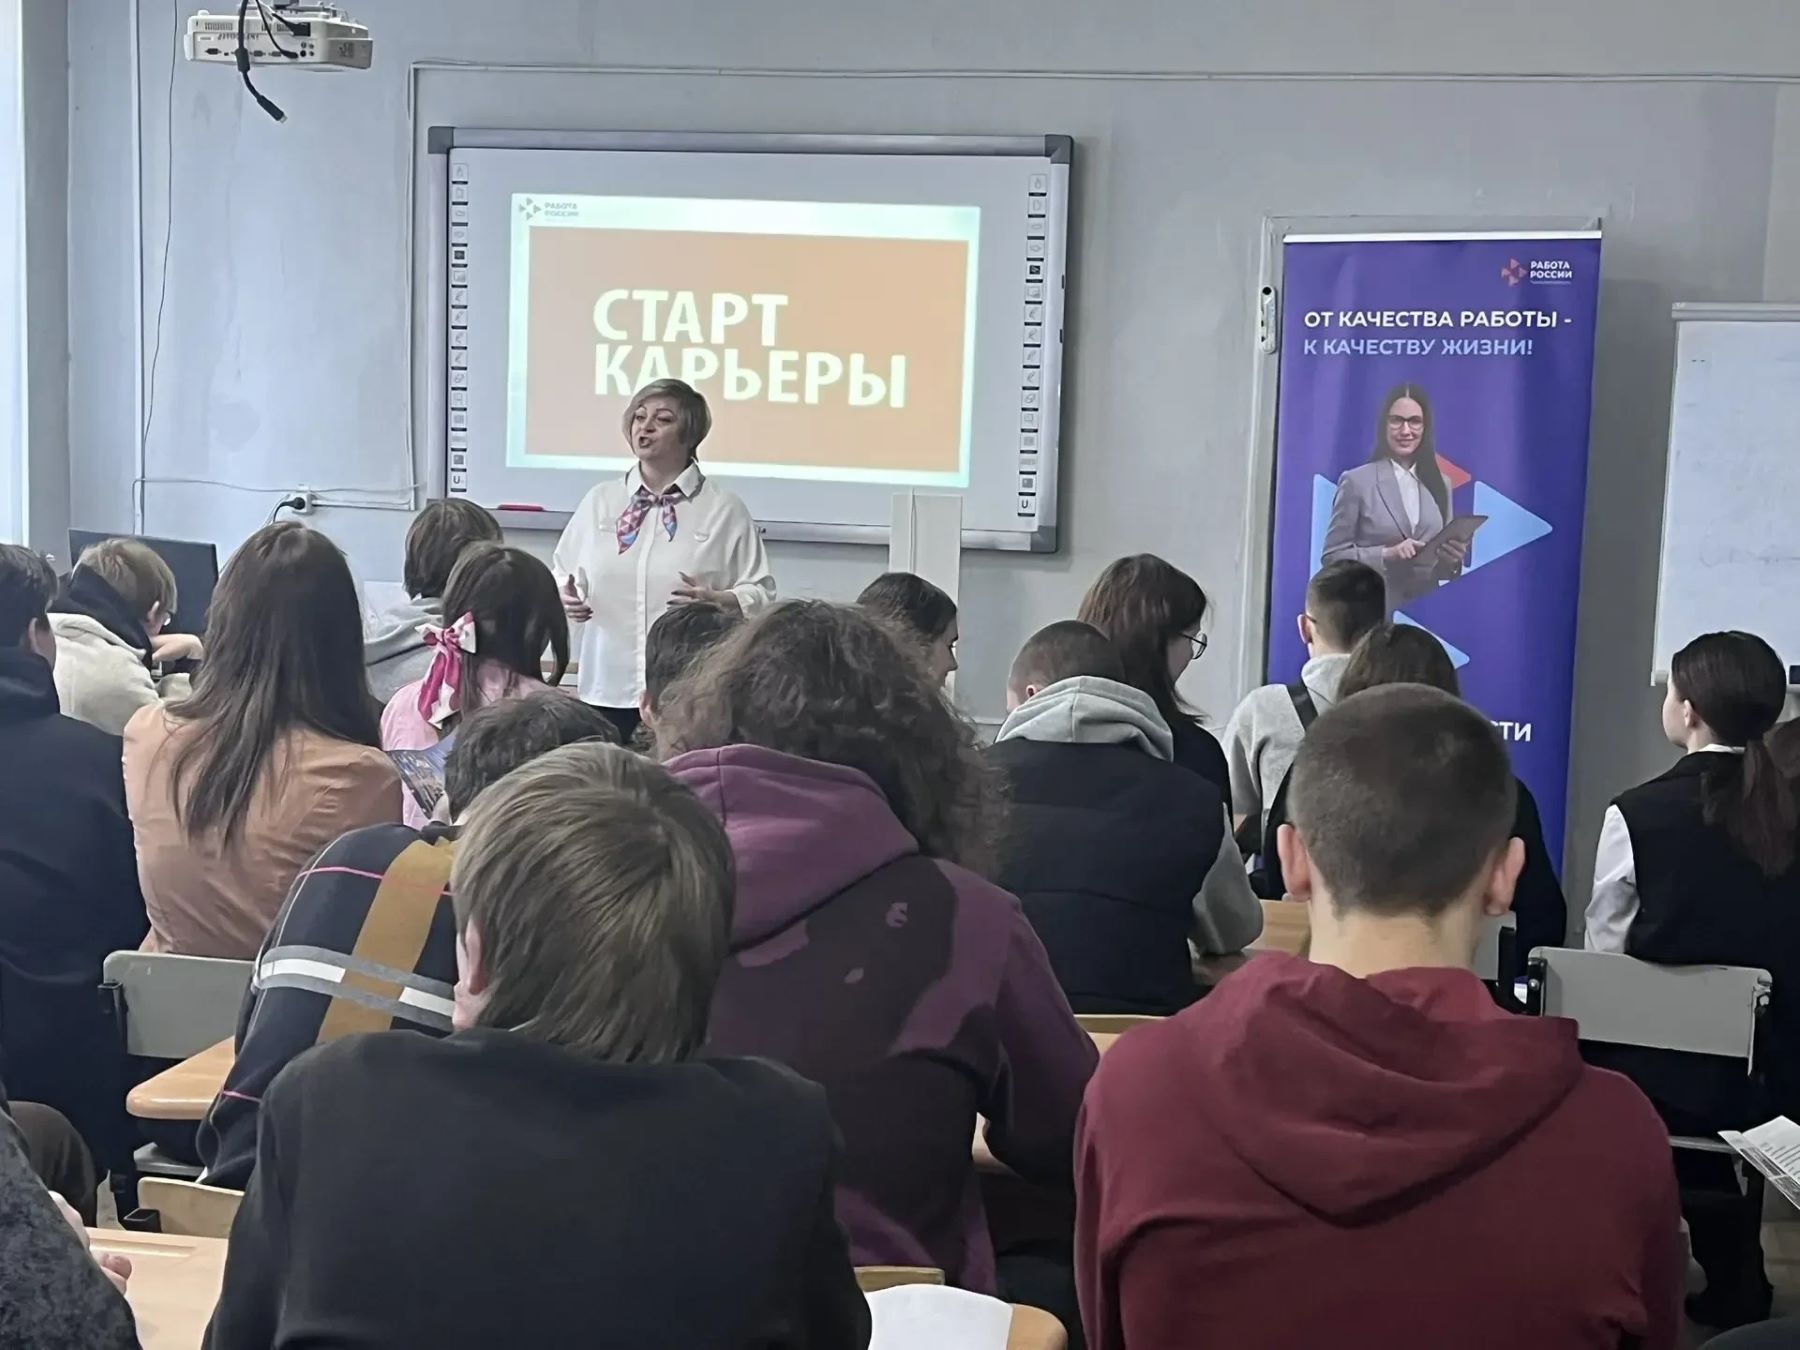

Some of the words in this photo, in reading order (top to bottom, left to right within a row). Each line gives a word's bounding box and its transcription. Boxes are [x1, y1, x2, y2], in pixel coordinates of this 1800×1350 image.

[1530, 261, 1570, 270] РАБОТА
[1530, 270, 1572, 279] РОССИИ
[592, 288, 789, 346] СТАРТ
[1304, 311, 1334, 328] ОТ
[1339, 311, 1454, 328] КАЧЕСТВА
[1460, 311, 1557, 328] РАБОТЫ
[1304, 339, 1317, 355] К
[1324, 339, 1436, 355] КАЧЕСТВУ
[1441, 339, 1533, 355] ЖИЗНИ!
[594, 343, 907, 408] КАРЬЕРЫ
[1490, 720, 1532, 742] ТИ
